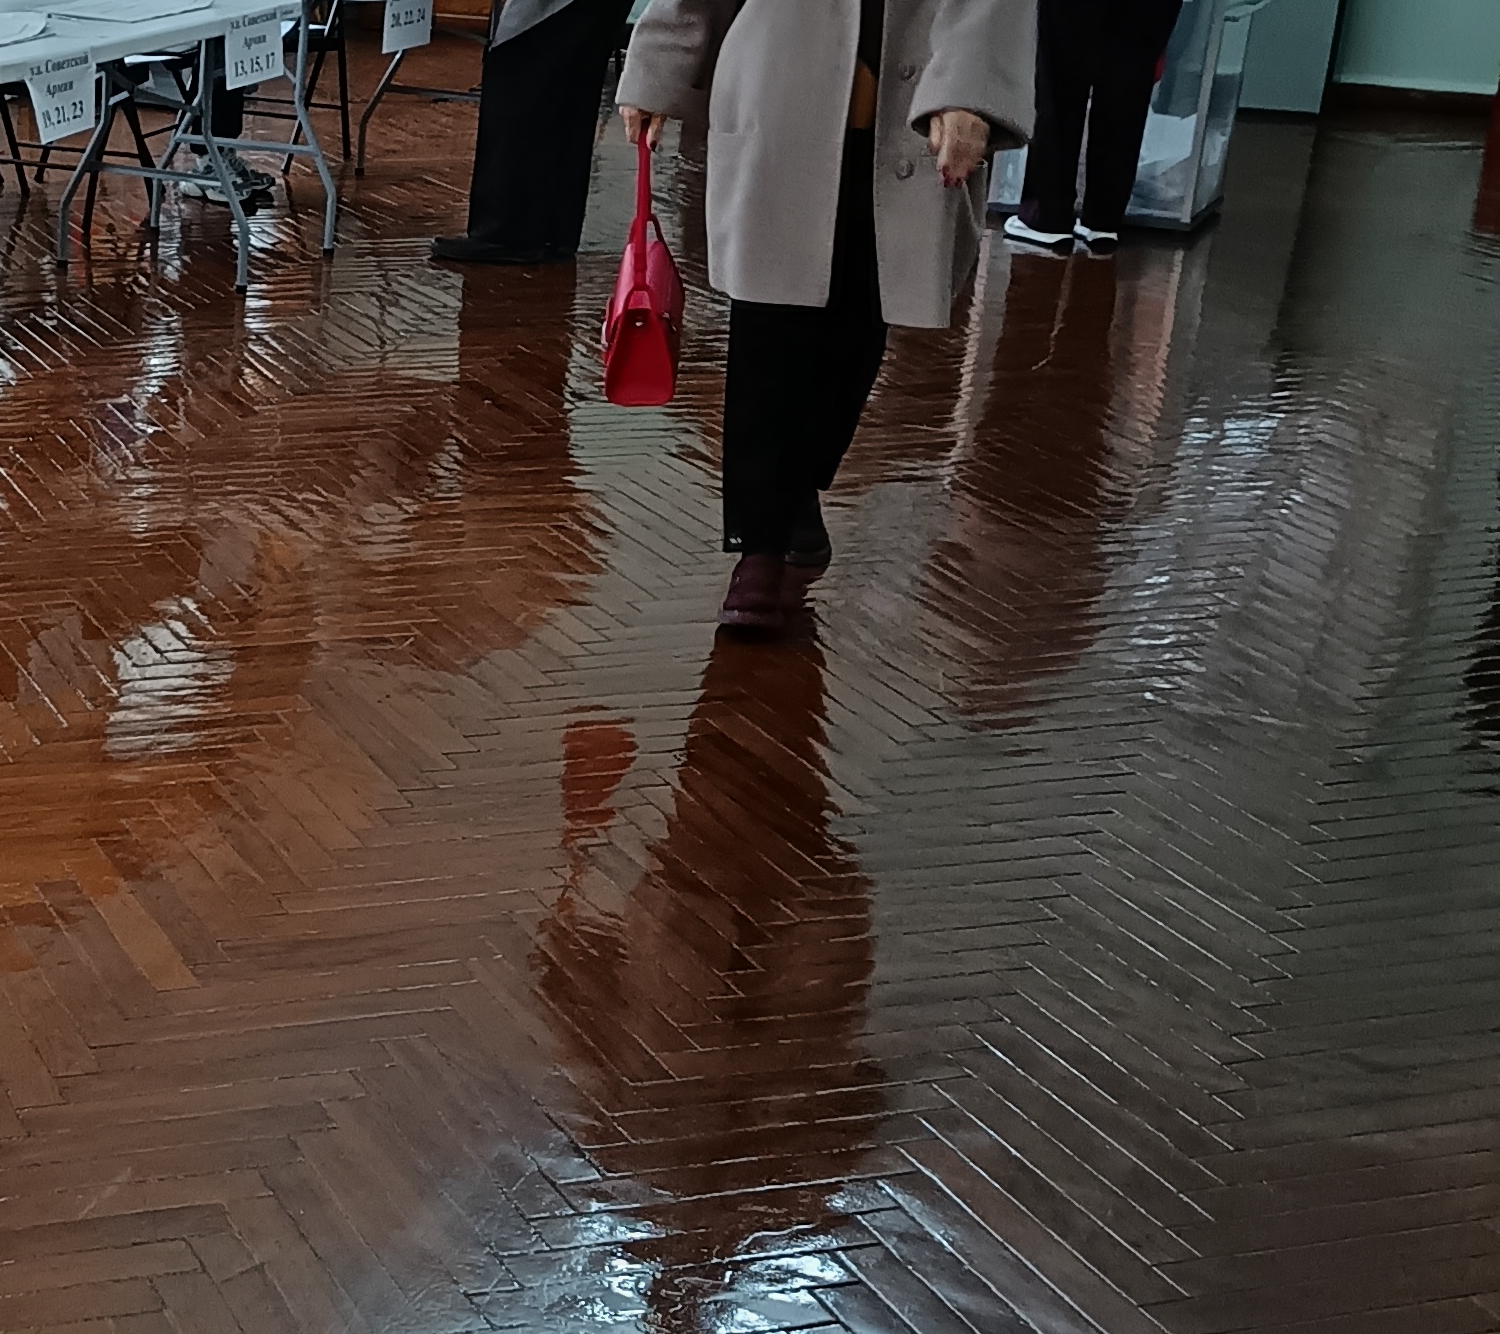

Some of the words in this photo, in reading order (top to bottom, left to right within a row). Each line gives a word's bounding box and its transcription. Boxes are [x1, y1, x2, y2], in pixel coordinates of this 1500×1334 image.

[265, 52, 275, 69] 17
[46, 80, 73, 98] Армии
[71, 100, 83, 119] 23
